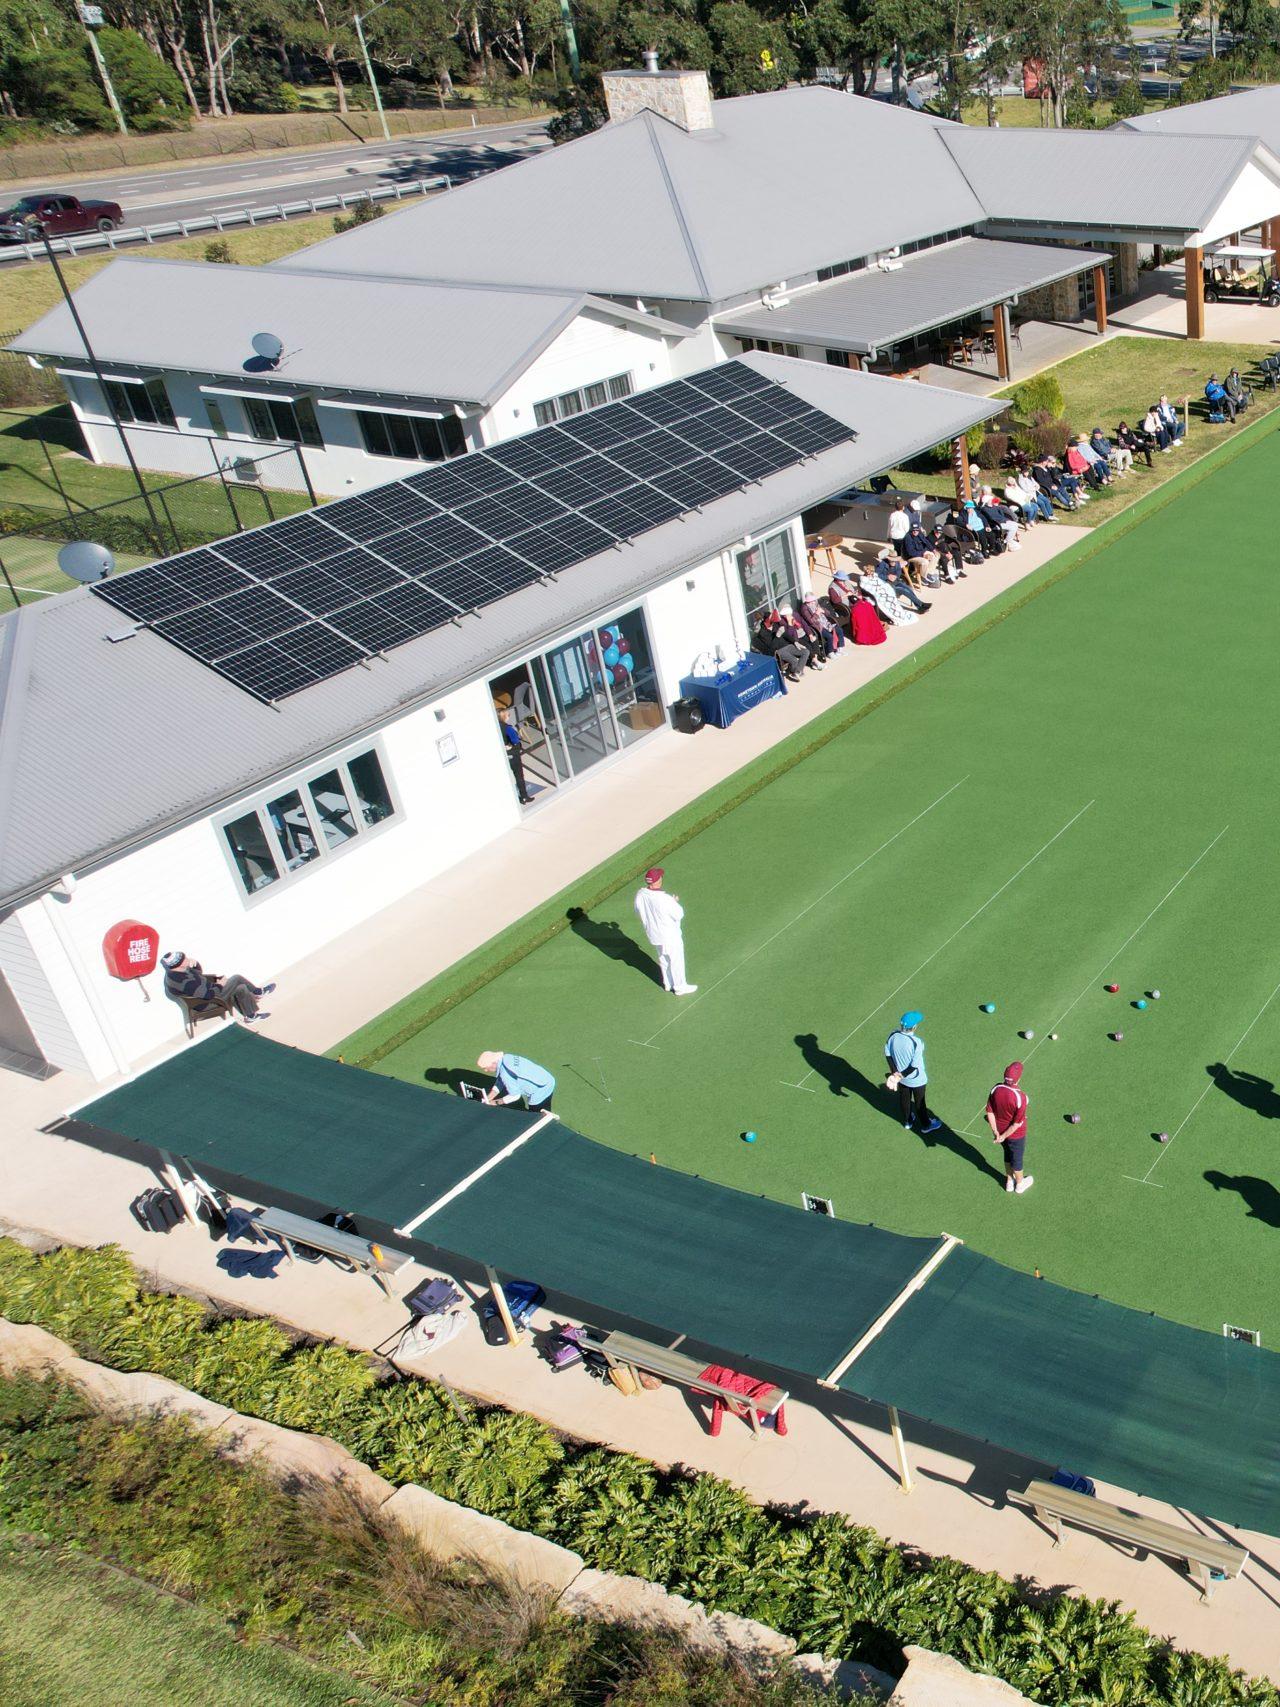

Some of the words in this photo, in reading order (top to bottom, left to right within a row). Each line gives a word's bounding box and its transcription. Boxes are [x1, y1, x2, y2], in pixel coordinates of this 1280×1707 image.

[130, 938, 149, 949] FIRE
[128, 945, 151, 956] HOSE
[130, 953, 151, 963] REEL
